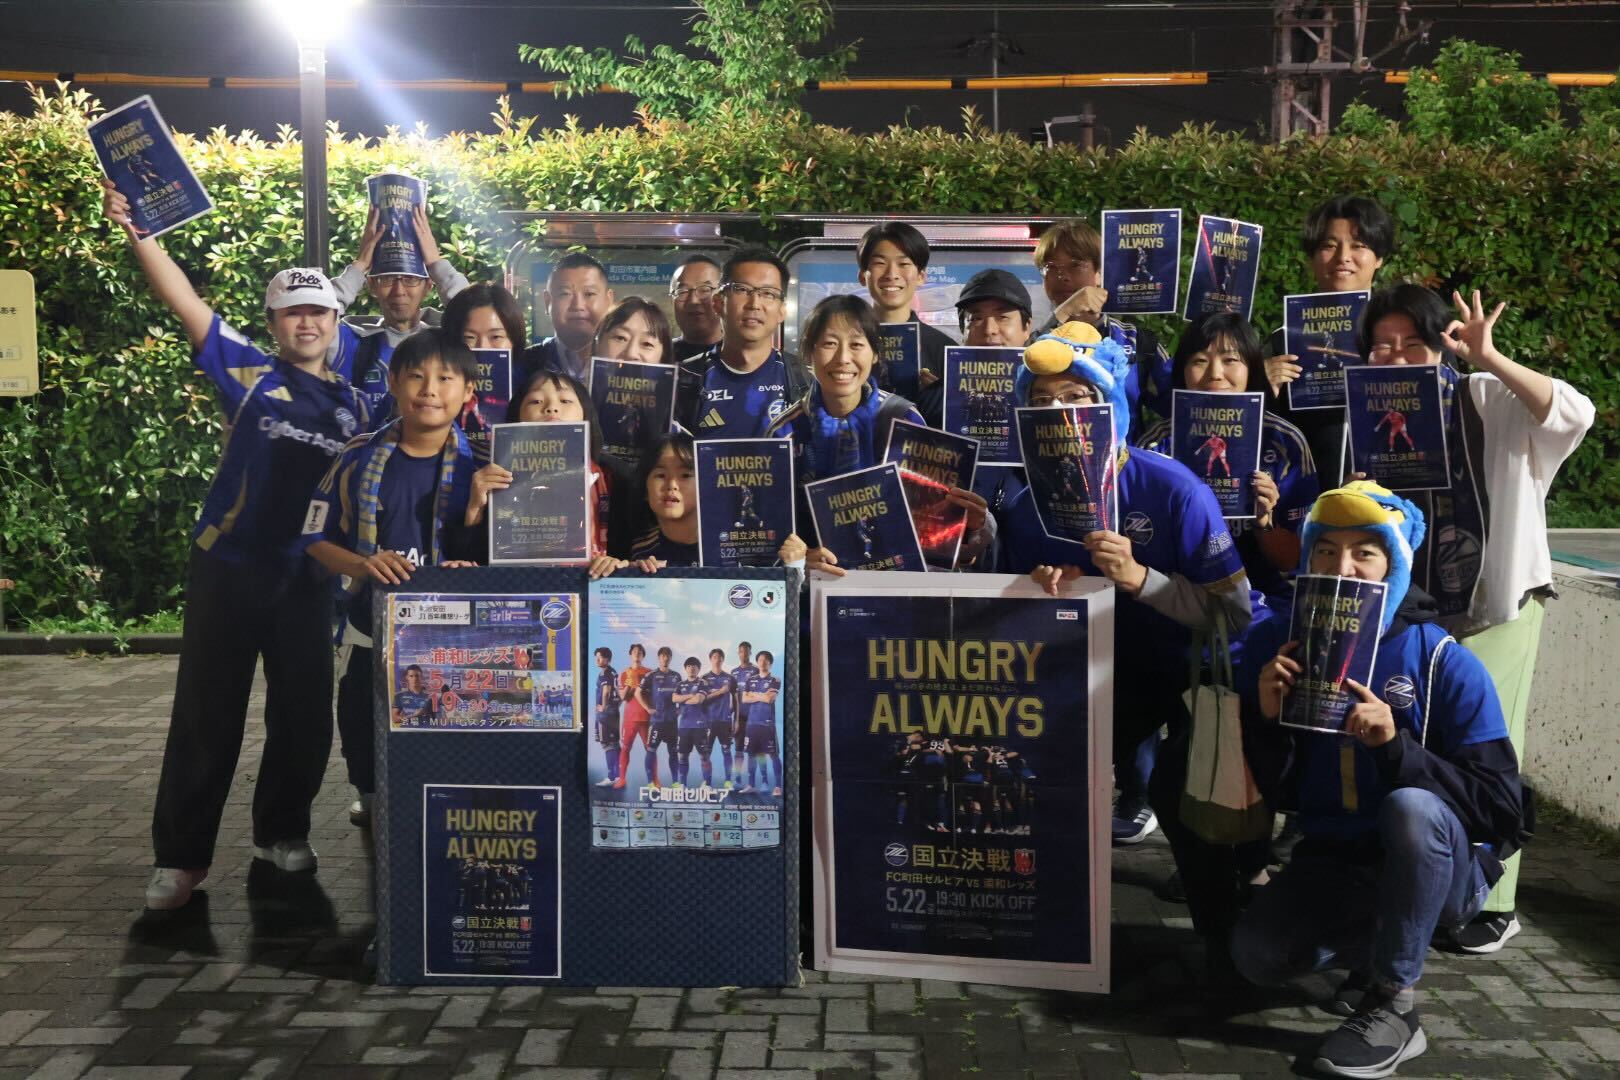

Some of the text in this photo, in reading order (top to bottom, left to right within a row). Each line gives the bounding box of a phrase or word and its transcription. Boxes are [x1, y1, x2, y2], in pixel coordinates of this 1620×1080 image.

[103, 119, 144, 147] HUNGRY
[111, 134, 154, 163] ALWAYS
[1118, 224, 1164, 236] HUNGRY
[1118, 238, 1164, 249] ALWAYS
[1212, 232, 1250, 246] HUNGRY
[1212, 245, 1248, 262] ALWAYS
[1302, 305, 1352, 320] HUNGRY
[1302, 320, 1352, 334] ALWAYS
[884, 336, 903, 348] GRY
[885, 350, 904, 361] AYS
[959, 361, 1014, 376] HUNGRY
[608, 376, 658, 392] HUNGRY
[959, 378, 1014, 392] ALWAYS
[1364, 380, 1420, 395] HUNGRY
[606, 391, 656, 408] ALWAYS
[1366, 398, 1421, 412] ALWAYS
[1190, 407, 1244, 421] HUNGRY
[1035, 423, 1093, 439] HUNGRY
[1190, 423, 1243, 437] ALWAYS
[511, 440, 566, 454] HUNGRY
[902, 440, 963, 467] HUNGRY
[1038, 441, 1094, 457] ALWAYS
[511, 457, 566, 472] ALWAYS
[716, 456, 772, 471] HUNGRY
[717, 473, 772, 488] ALWAYS
[828, 484, 882, 510] HUNGRY
[834, 501, 888, 527] ALWAYS
[431, 647, 511, 665] 浦和レッズ
[868, 638, 1044, 682] HUNGRY
[868, 693, 1045, 738] ALWAYS
[639, 784, 734, 803] FC町田ゼルビア
[446, 809, 537, 832] HUNGRY
[447, 837, 537, 859] ALWAYS
[912, 844, 1011, 872] 国立決戦
[886, 872, 964, 888] FC町田ゼルビア
[984, 879, 1036, 889] 浦和レッズ
[886, 887, 926, 914] 5.22
[936, 890, 966, 907] 19:30
[970, 894, 1005, 909] KICK
[1008, 896, 1037, 910] OFF
[466, 917, 519, 929] 国立決戦
